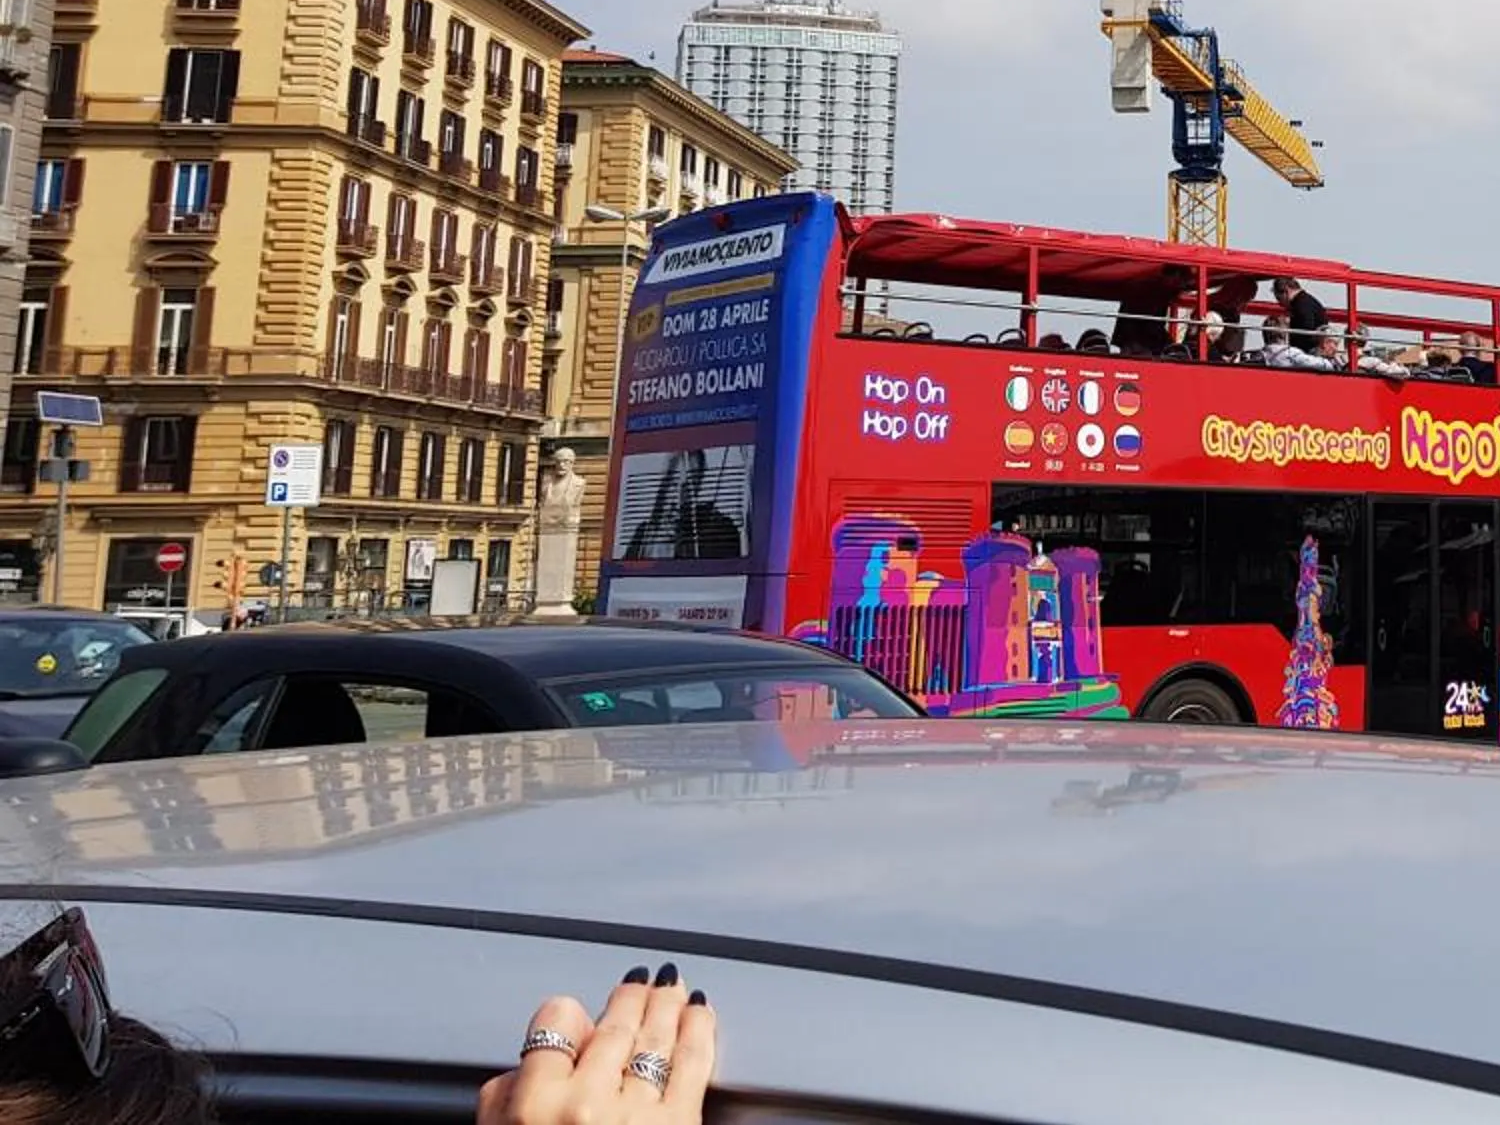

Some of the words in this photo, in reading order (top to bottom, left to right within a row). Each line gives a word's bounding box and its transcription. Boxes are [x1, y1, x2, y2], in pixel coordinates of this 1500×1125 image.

[663, 310, 695, 338] DOM
[699, 307, 717, 328] 28
[720, 299, 769, 328] APRILE
[751, 332, 767, 355] SA
[628, 372, 692, 404] STEFANO
[696, 362, 765, 395] BOLLANI
[864, 374, 909, 404] Hop
[915, 376, 945, 403] On
[862, 410, 907, 439] Hop
[914, 412, 949, 439] Off
[1202, 415, 1391, 469] CitySightseeing
[273, 484, 285, 500] P
